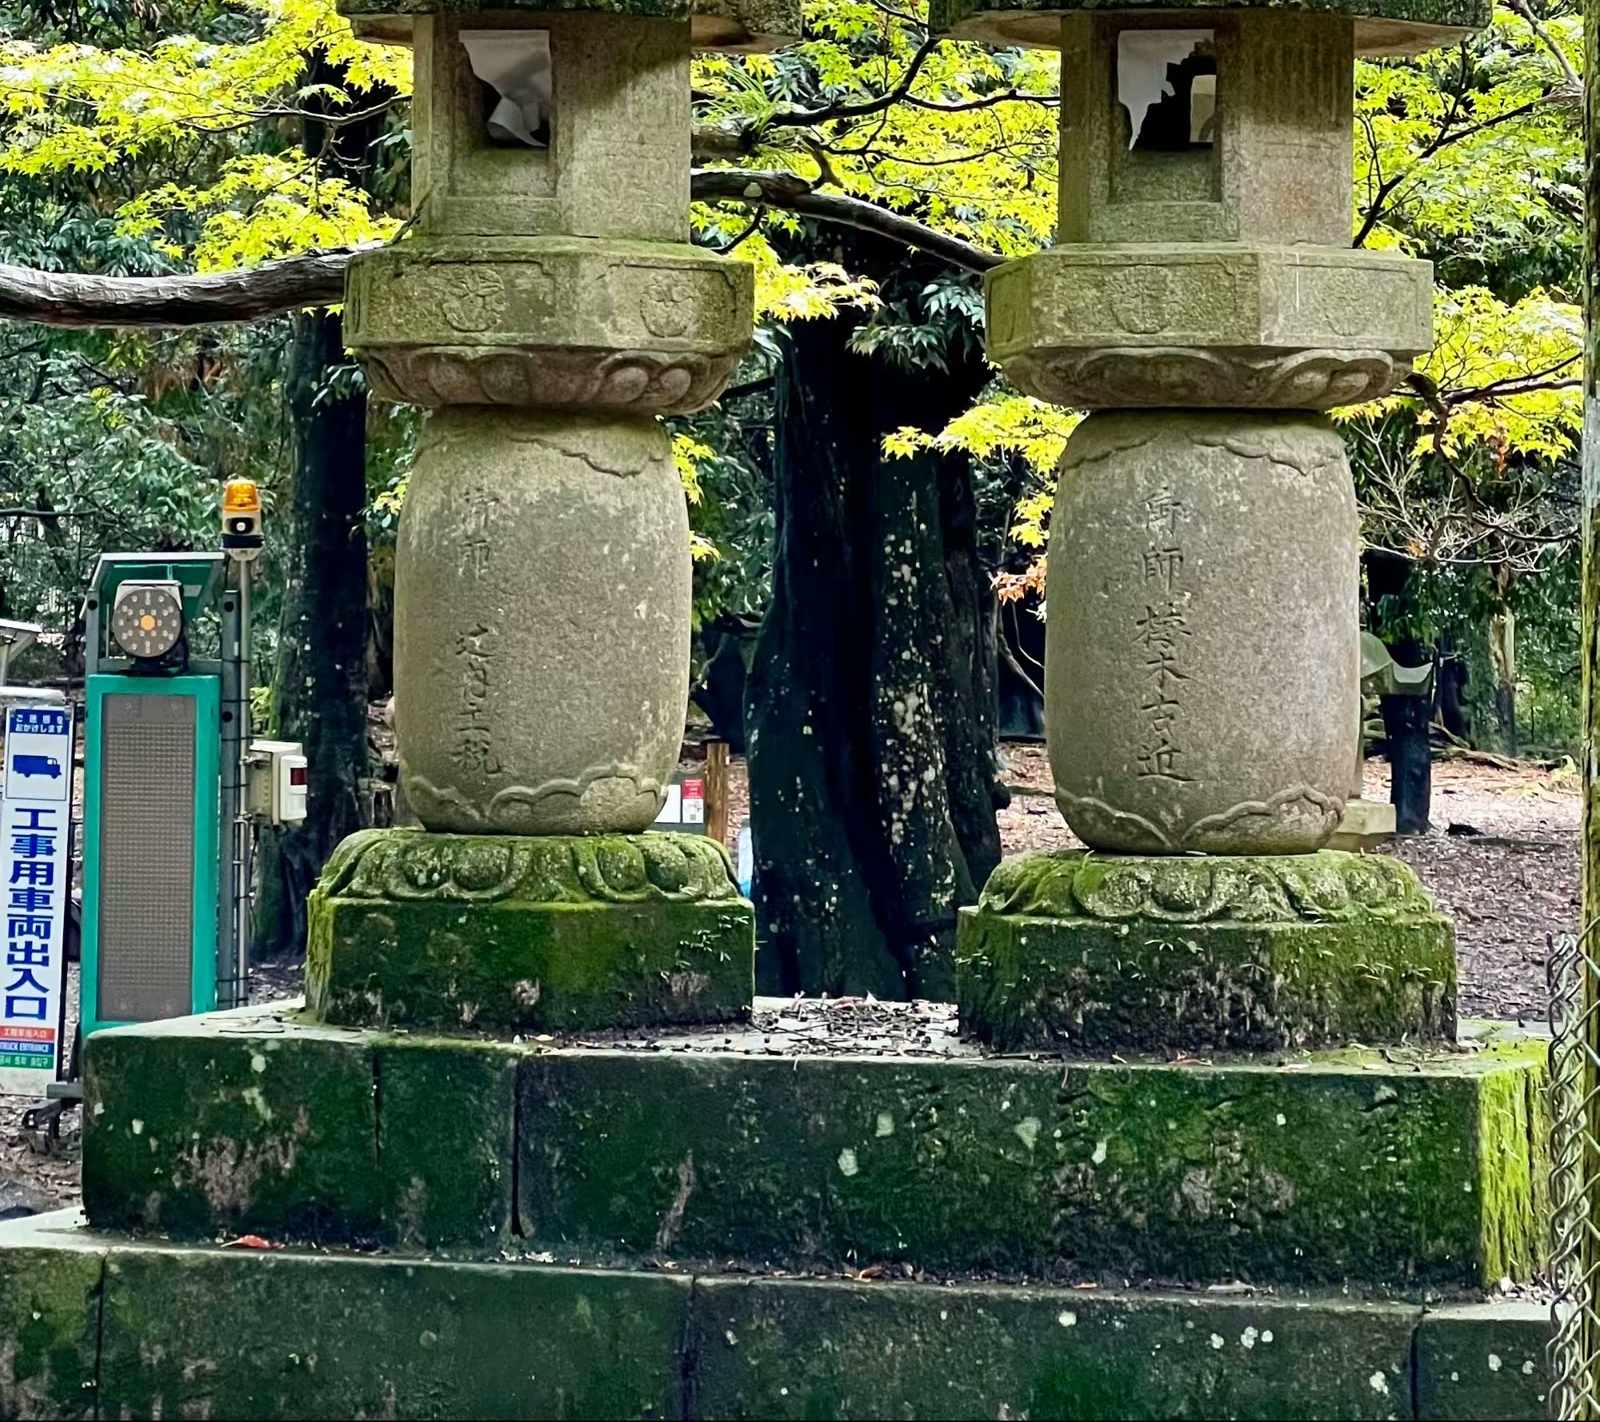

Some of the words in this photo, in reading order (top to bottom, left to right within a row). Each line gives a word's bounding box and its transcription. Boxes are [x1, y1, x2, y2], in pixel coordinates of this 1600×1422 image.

[4, 808, 57, 1020] 工事用車両出入口
